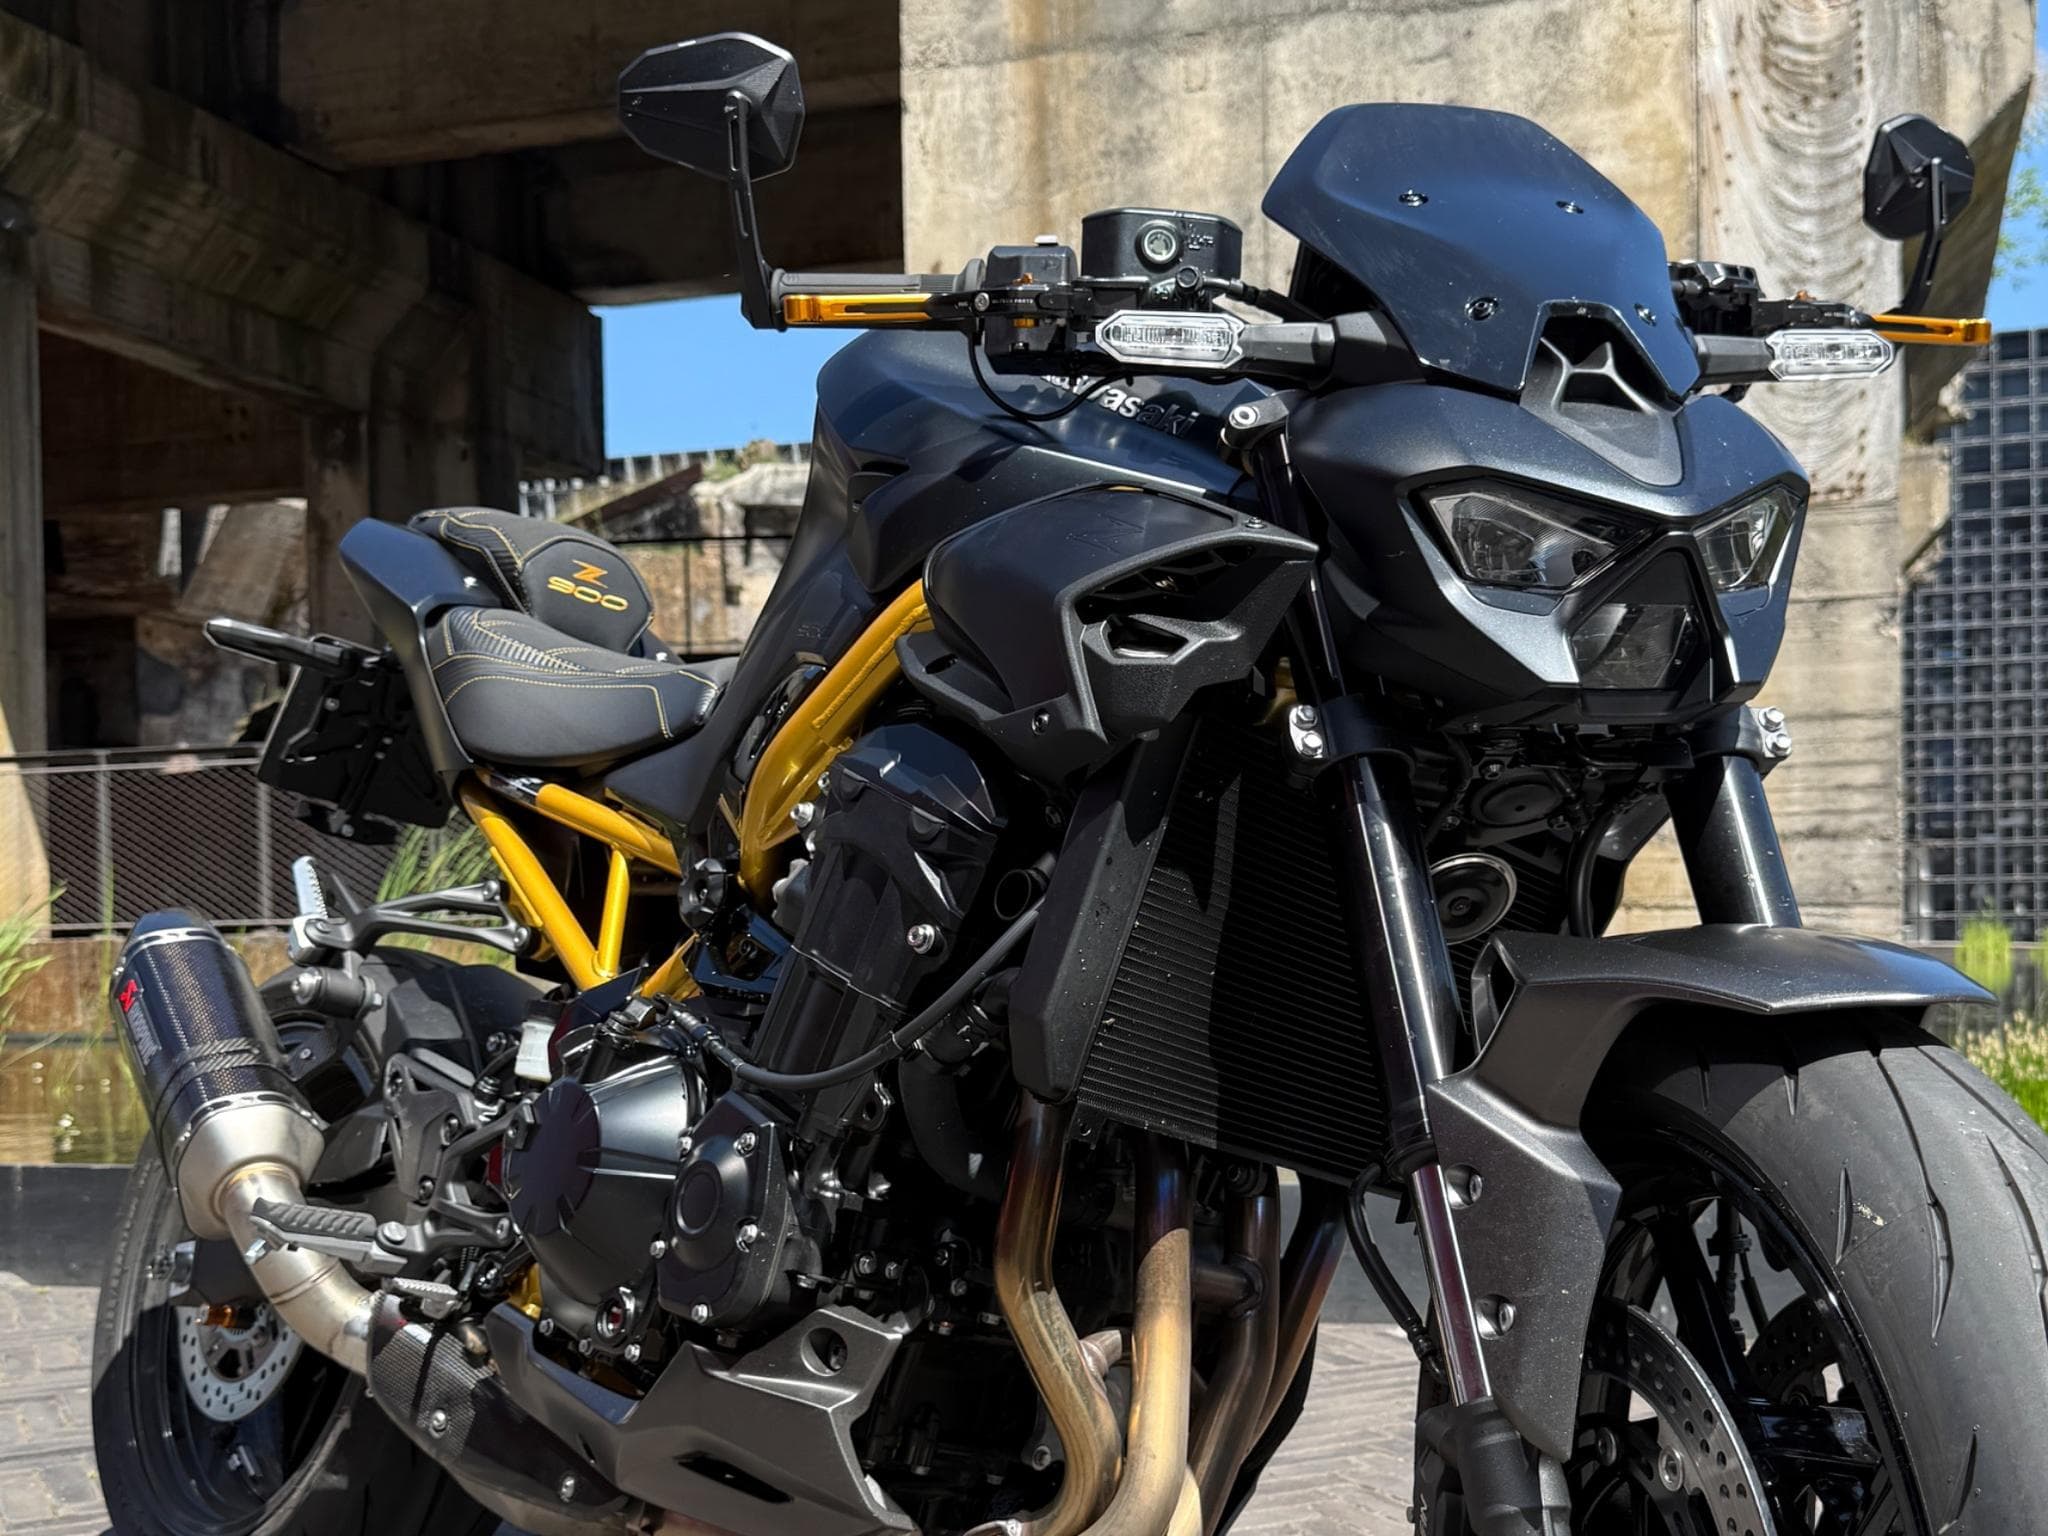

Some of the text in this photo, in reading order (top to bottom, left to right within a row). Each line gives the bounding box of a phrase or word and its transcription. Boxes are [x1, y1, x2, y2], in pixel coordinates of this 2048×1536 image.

[1040, 374, 1201, 437] awasaki
[571, 559, 609, 590] Z
[546, 575, 629, 612] 900
